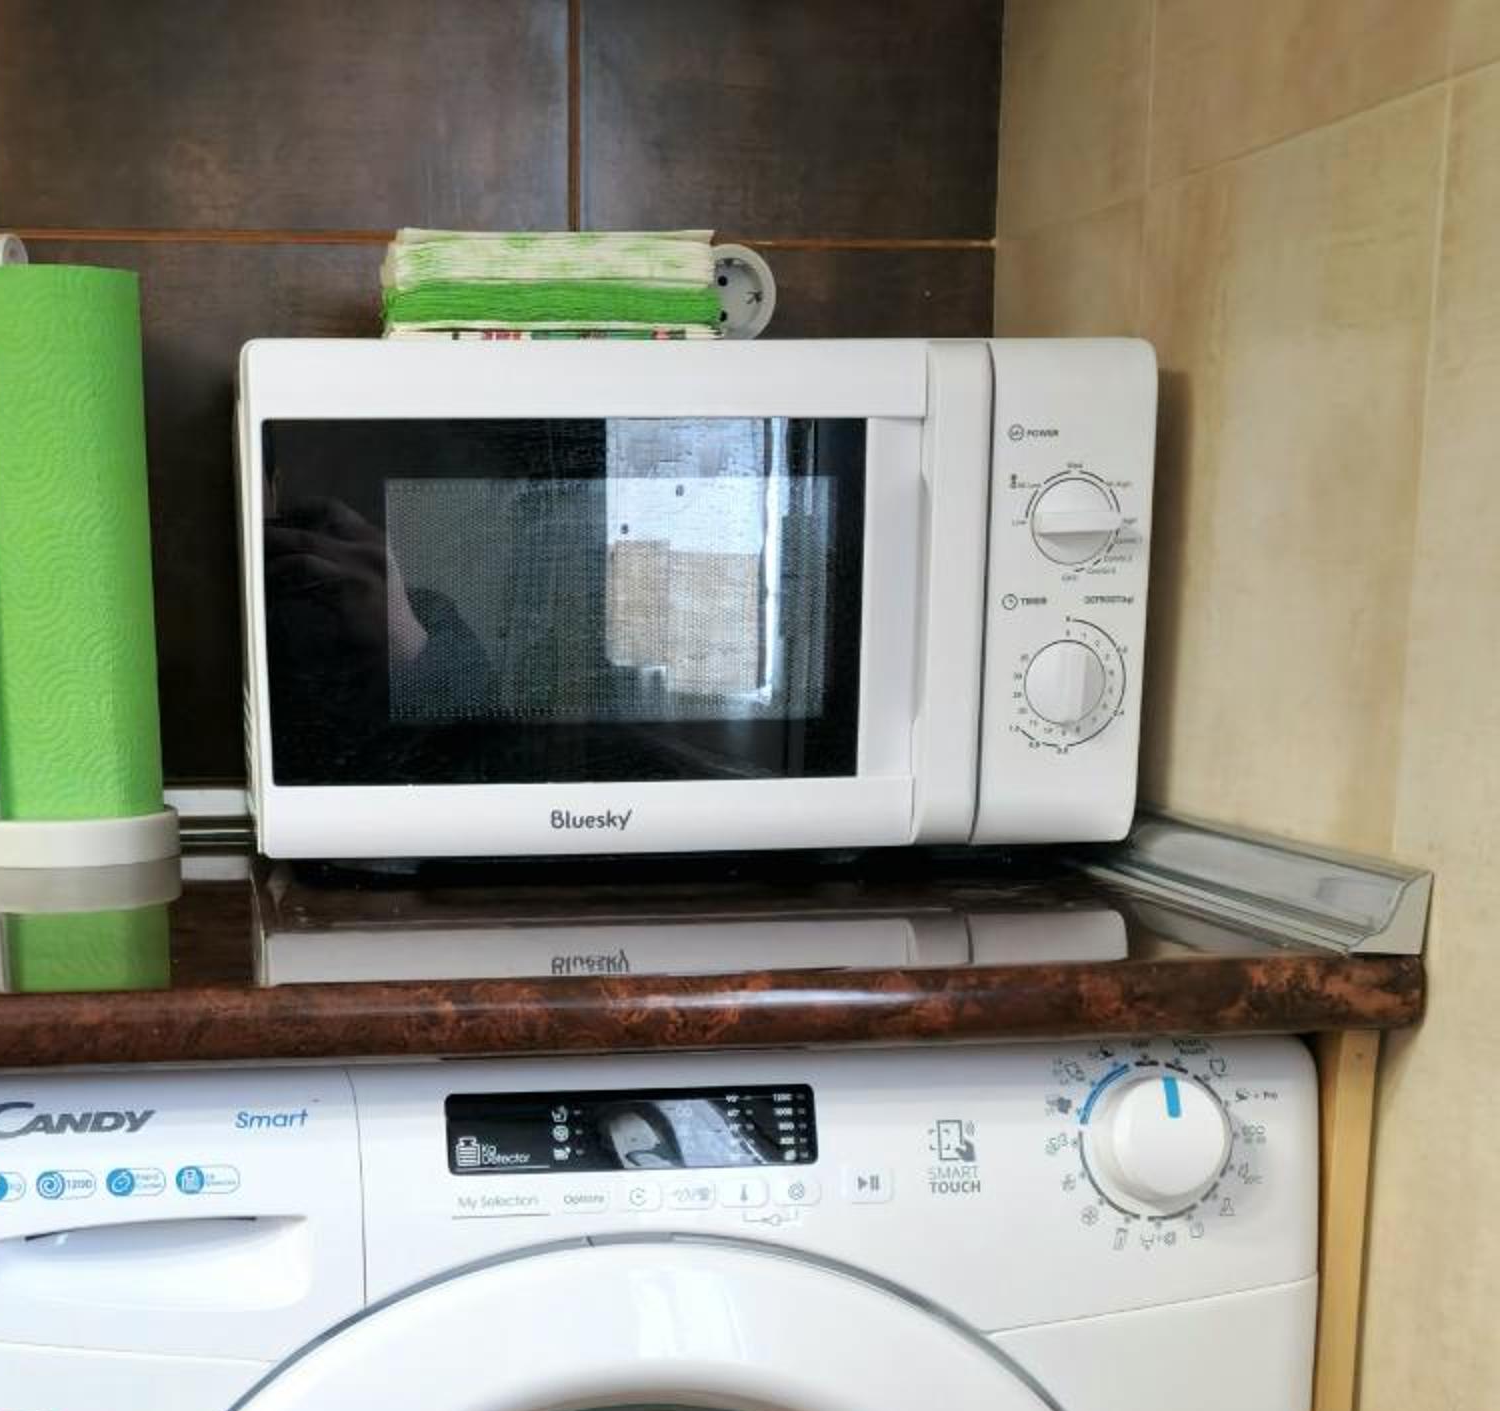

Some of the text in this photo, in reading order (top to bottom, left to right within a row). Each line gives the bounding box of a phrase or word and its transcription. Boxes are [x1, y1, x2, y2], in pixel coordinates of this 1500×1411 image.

[550, 809, 632, 831] Bluesky
[235, 1108, 309, 1129] Smart
[928, 1166, 979, 1180] SMART
[929, 1181, 980, 1193] TOUCH
